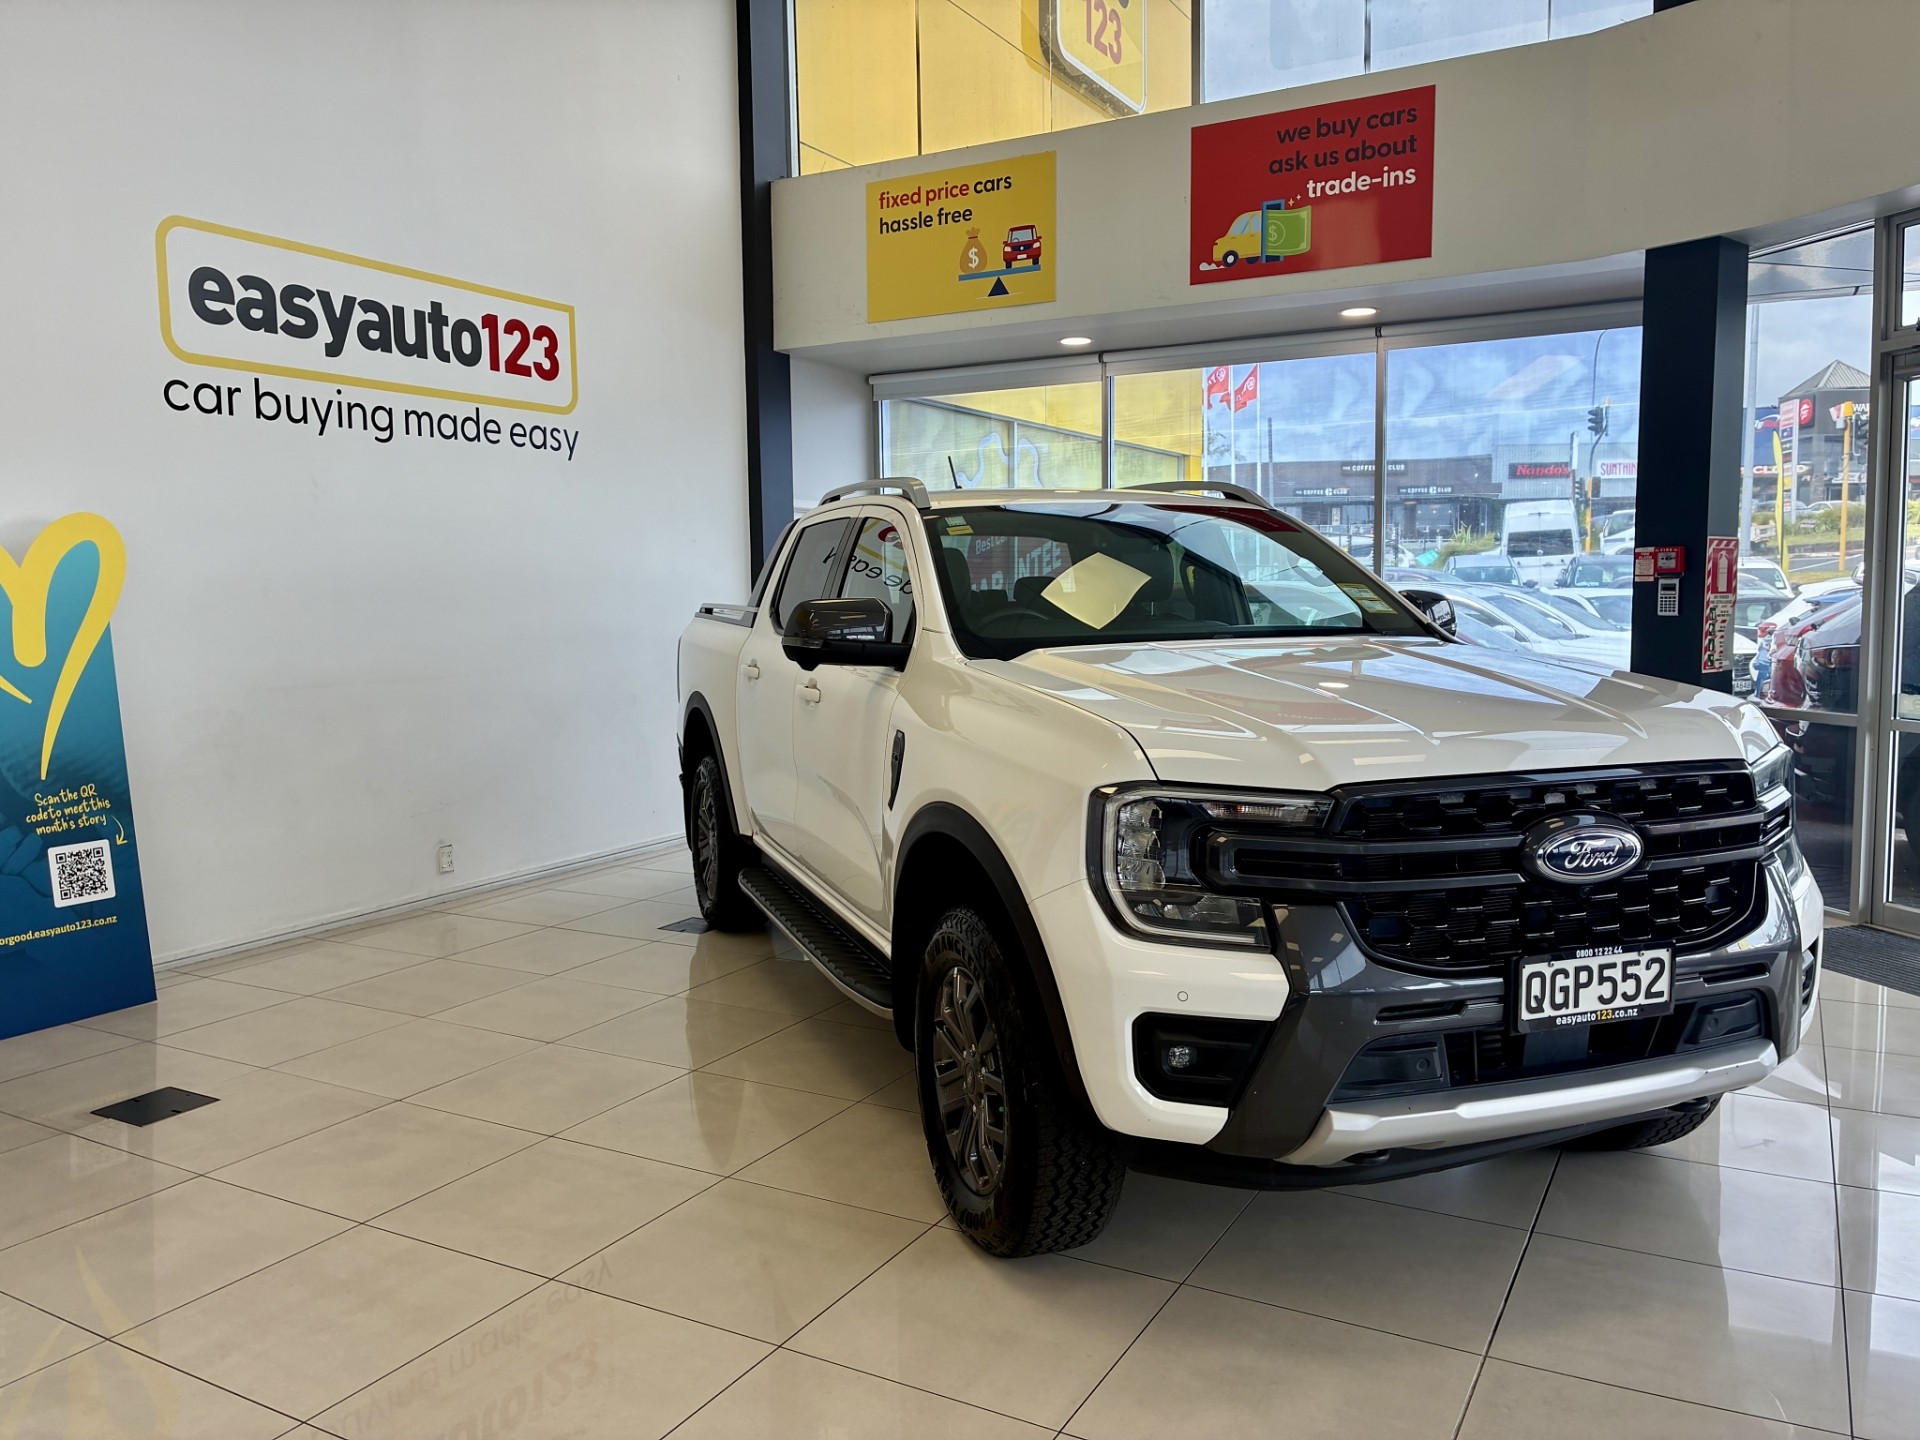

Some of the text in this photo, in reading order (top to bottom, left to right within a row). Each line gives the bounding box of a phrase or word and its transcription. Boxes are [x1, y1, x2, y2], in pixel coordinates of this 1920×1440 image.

[1276, 107, 1418, 144] we buy cars
[1268, 134, 1418, 174] ask us about
[878, 175, 1012, 210] fixed price cars
[1306, 166, 1417, 198] trade-ins
[879, 207, 973, 235] hassle free
[188, 265, 561, 382] easyauto123
[163, 377, 579, 461] car buying made easy
[1515, 464, 1569, 476] Nando's
[26, 798, 111, 823] code to meet this
[34, 783, 97, 807] Scan the QR
[36, 814, 107, 836] month's story
[1564, 838, 1619, 869] Ford
[1576, 945, 1623, 958] 0800 12 22 44
[1525, 956, 1666, 1015] QGP552
[1556, 1008, 1638, 1026] easyauto123.co.nz
